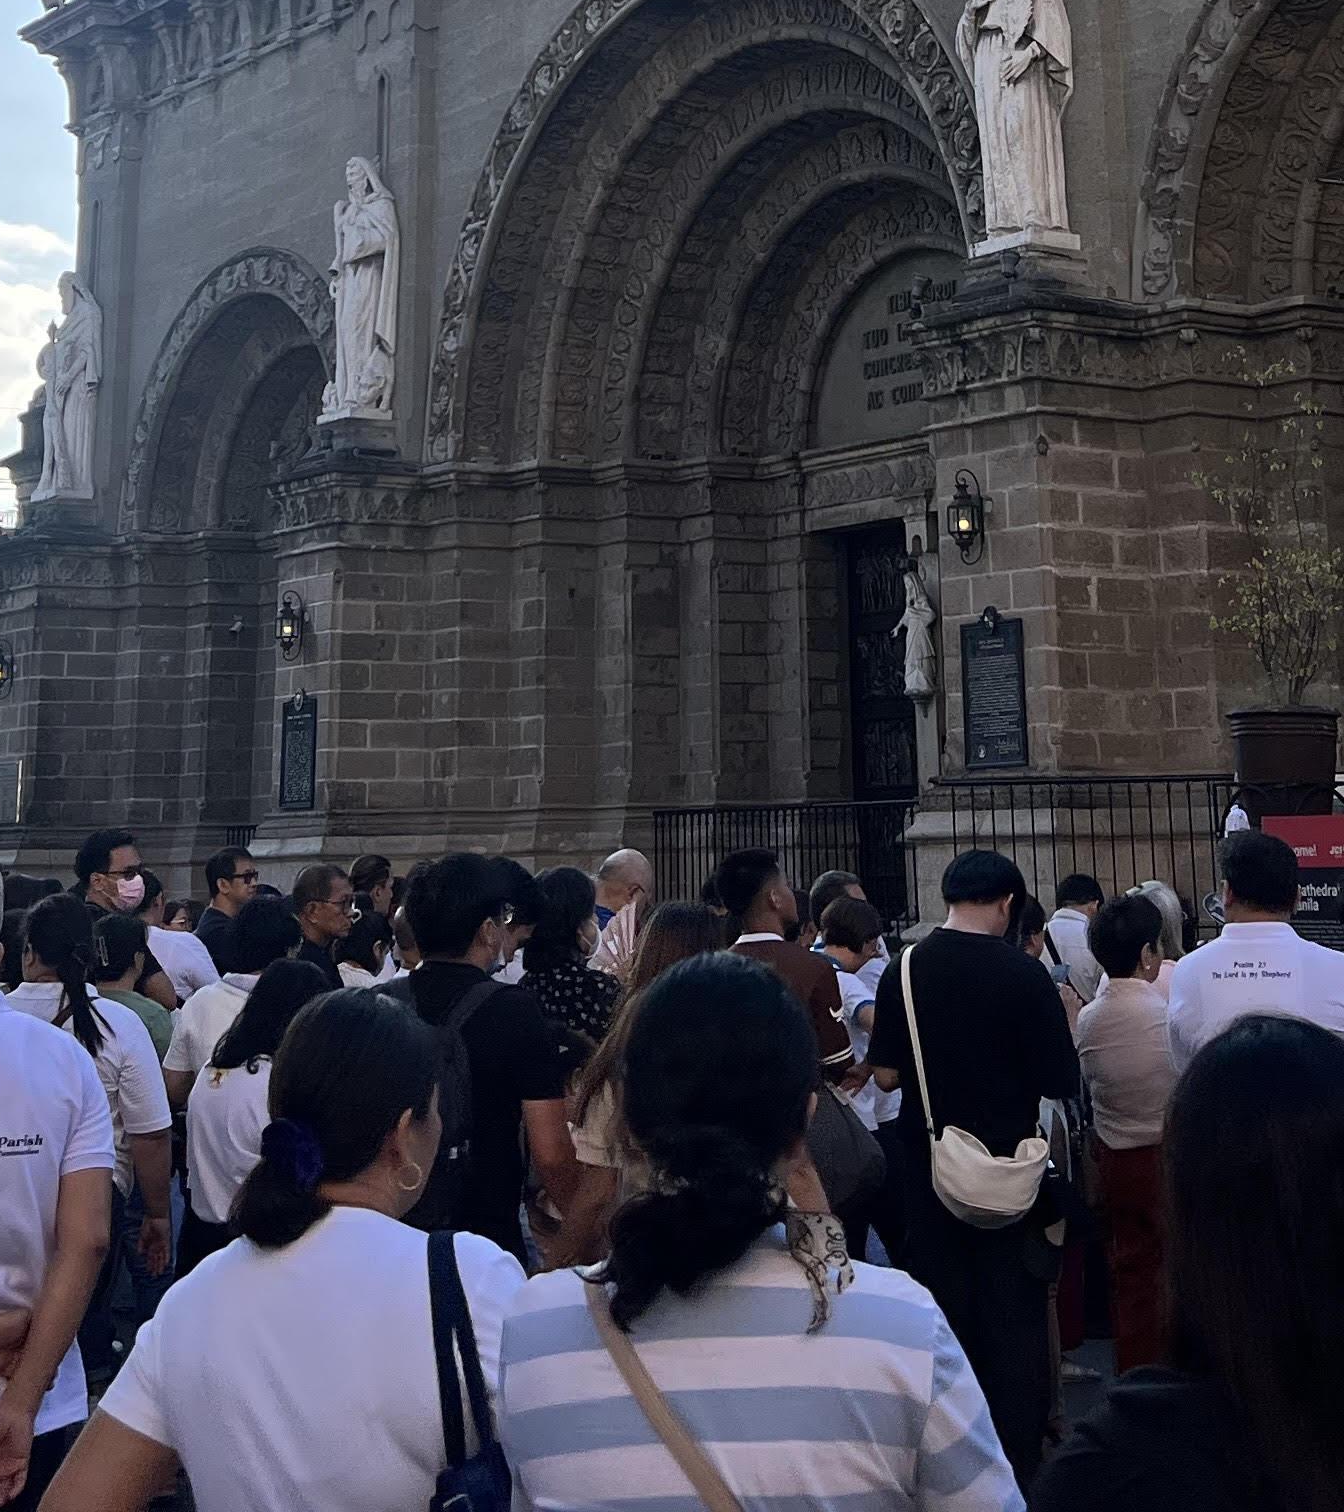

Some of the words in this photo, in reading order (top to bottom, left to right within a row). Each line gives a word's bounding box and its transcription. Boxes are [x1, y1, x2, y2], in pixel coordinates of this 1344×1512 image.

[1293, 843, 1318, 857] ome!
[1297, 883, 1341, 897] athedra
[1296, 897, 1319, 912] anila
[1224, 970, 1239, 979] Lord
